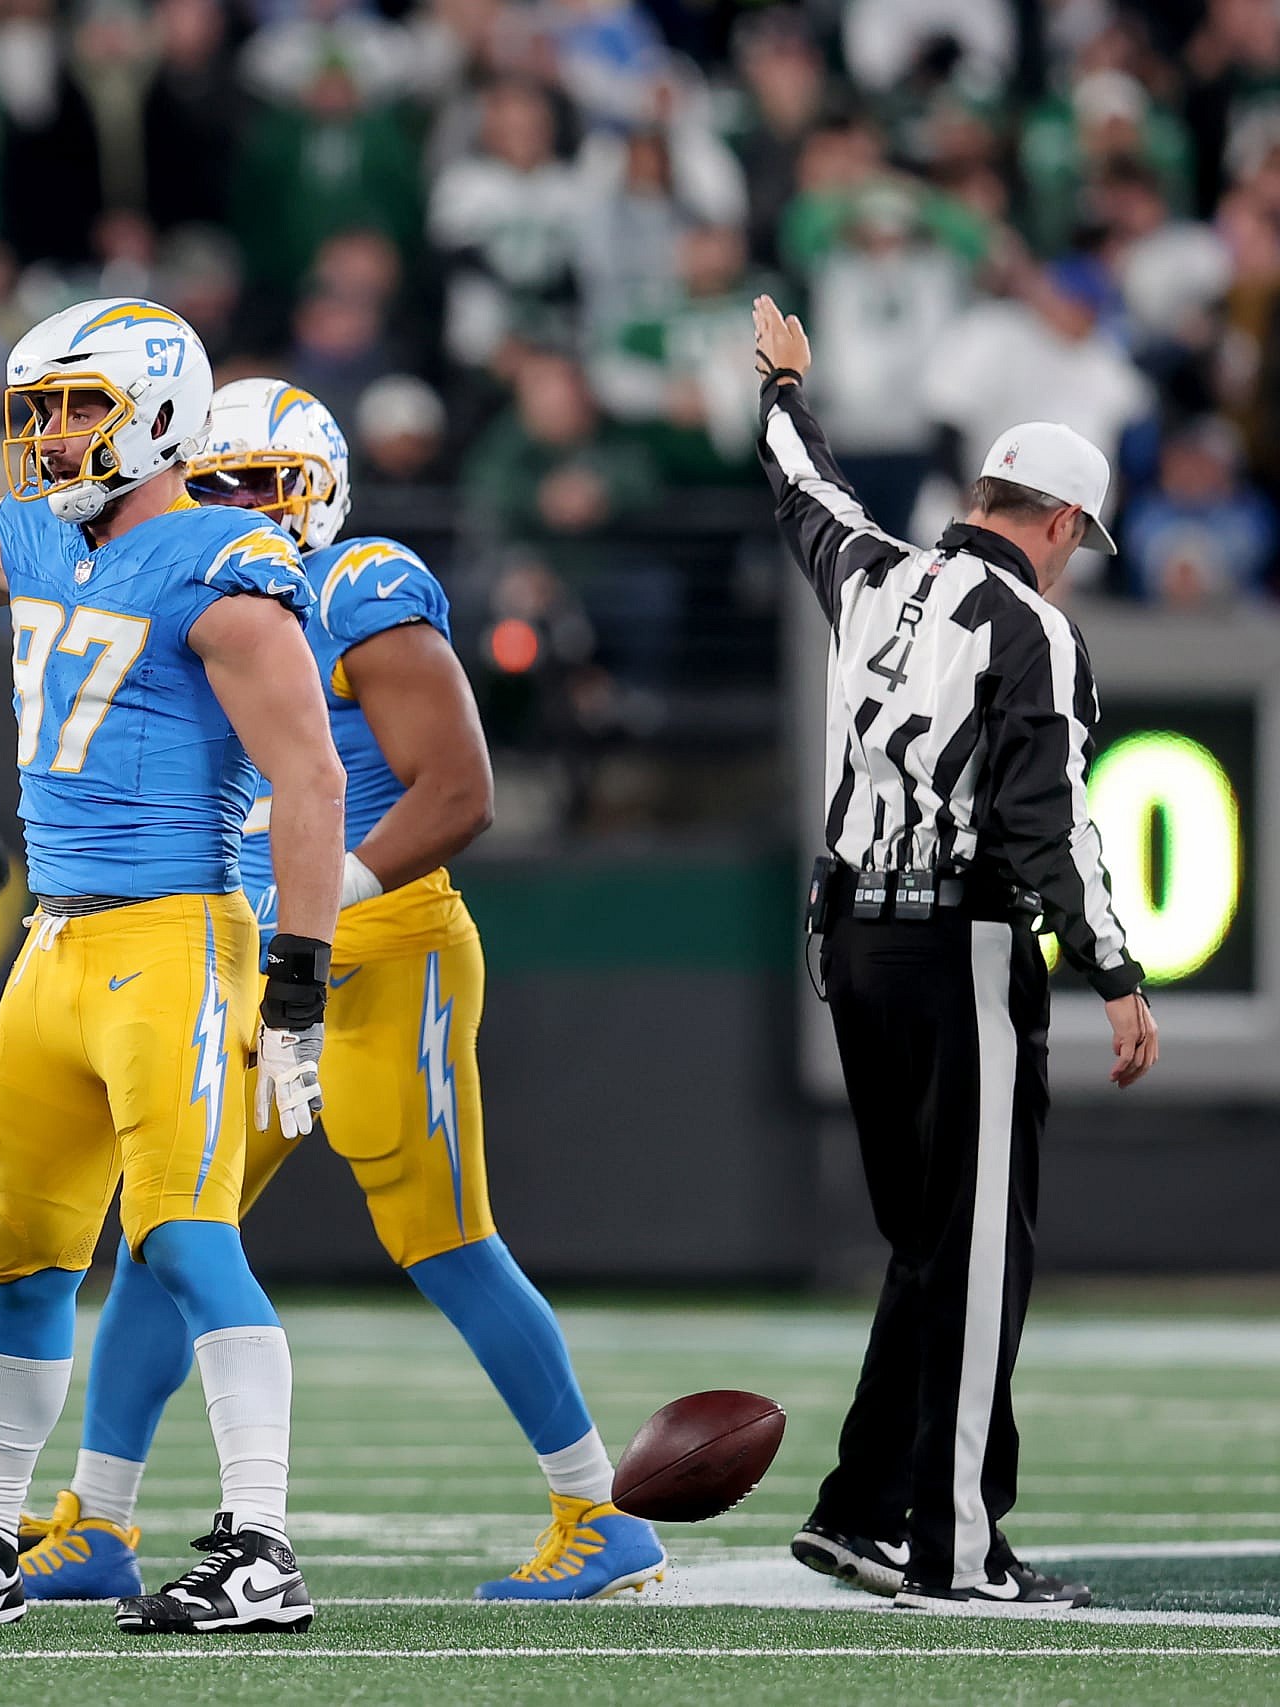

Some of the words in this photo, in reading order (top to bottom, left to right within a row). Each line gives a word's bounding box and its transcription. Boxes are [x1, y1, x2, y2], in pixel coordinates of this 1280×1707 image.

[145, 337, 185, 377] 97
[896, 602, 923, 638] R
[10, 596, 152, 774] 97
[867, 635, 914, 693] 4
